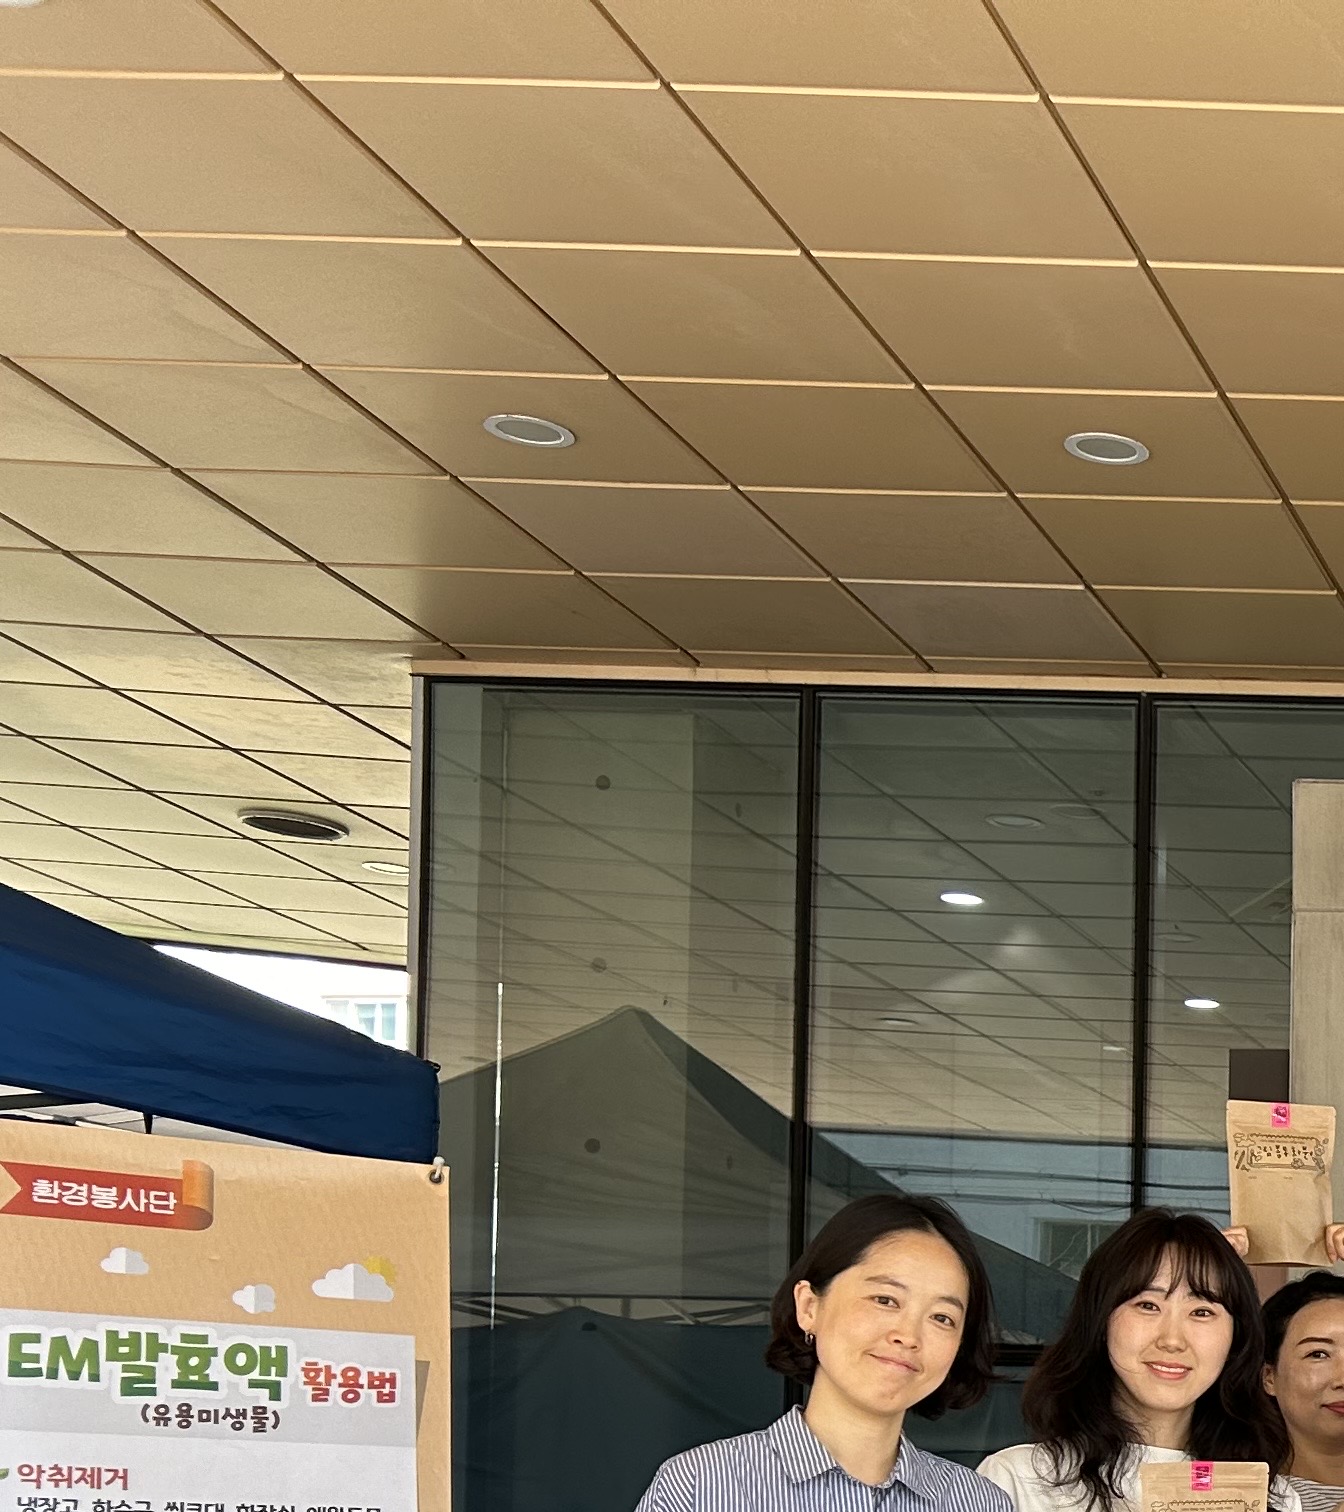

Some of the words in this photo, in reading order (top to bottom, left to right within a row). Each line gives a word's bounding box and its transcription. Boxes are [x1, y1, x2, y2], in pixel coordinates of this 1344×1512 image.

[31, 1179, 177, 1215] 환경봉사단
[7, 1329, 289, 1400] EM발효액
[301, 1361, 397, 1403] 활용법
[140, 1403, 281, 1433] (유용미생물)
[17, 1464, 129, 1490] 악취제거
